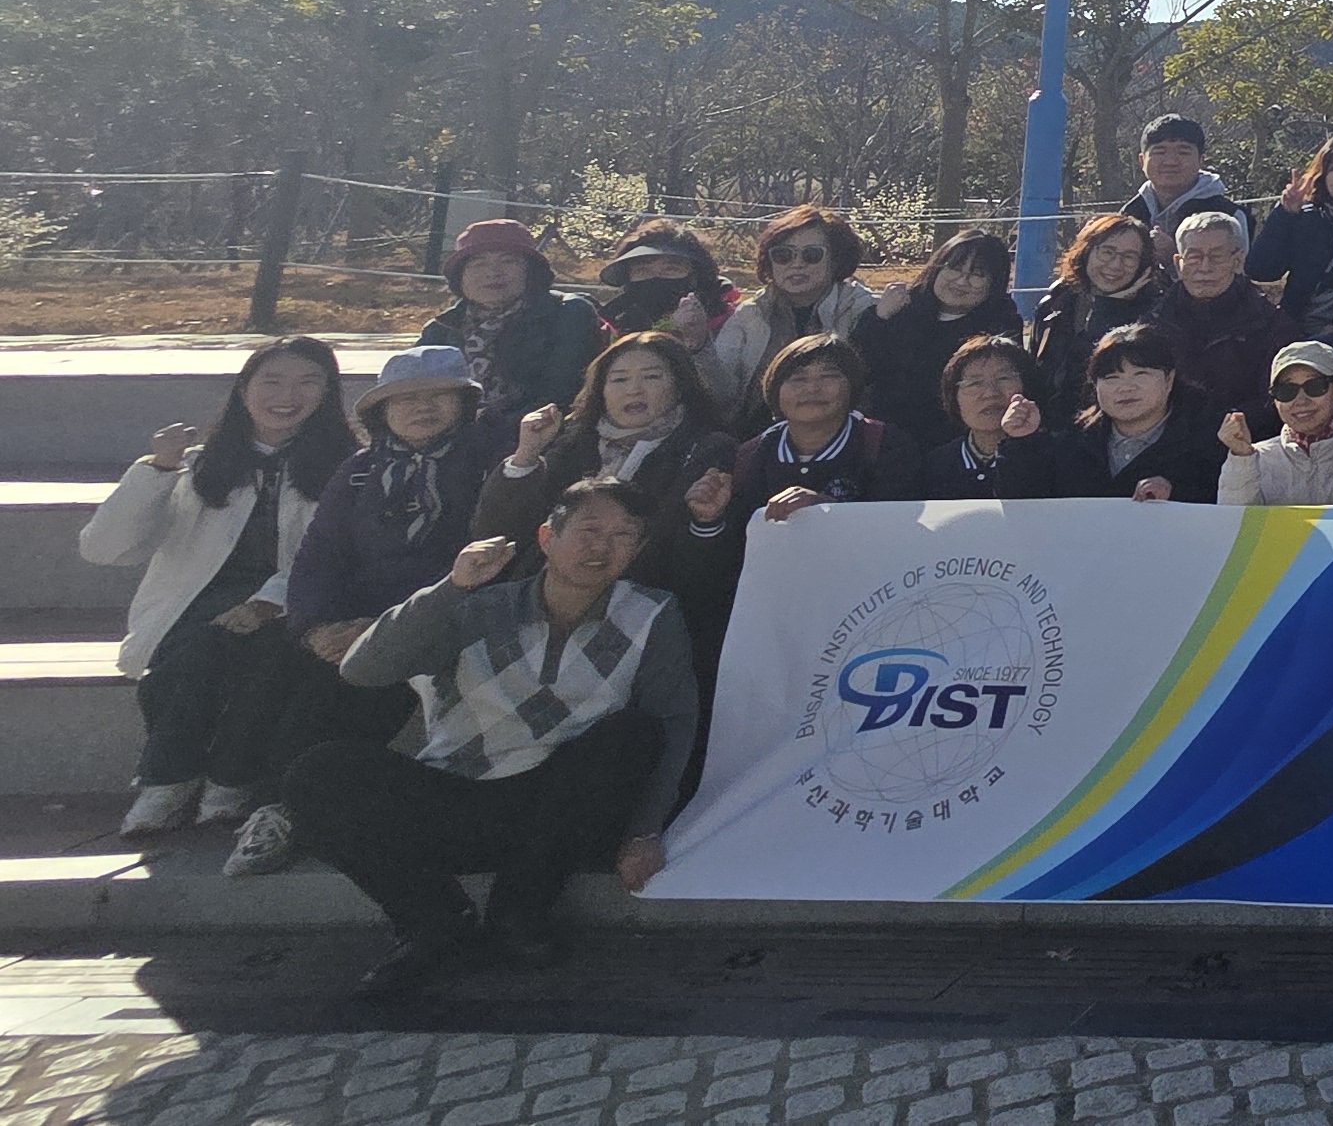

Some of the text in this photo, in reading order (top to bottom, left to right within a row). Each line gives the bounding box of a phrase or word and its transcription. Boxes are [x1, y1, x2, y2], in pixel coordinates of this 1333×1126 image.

[795, 556, 1064, 740] BUSAN INSTITUTE OF SCIENCE AND TECHNOLOGY
[952, 666, 1031, 683] SINCE 1977
[795, 765, 1006, 834] 부산과학기술대학교
